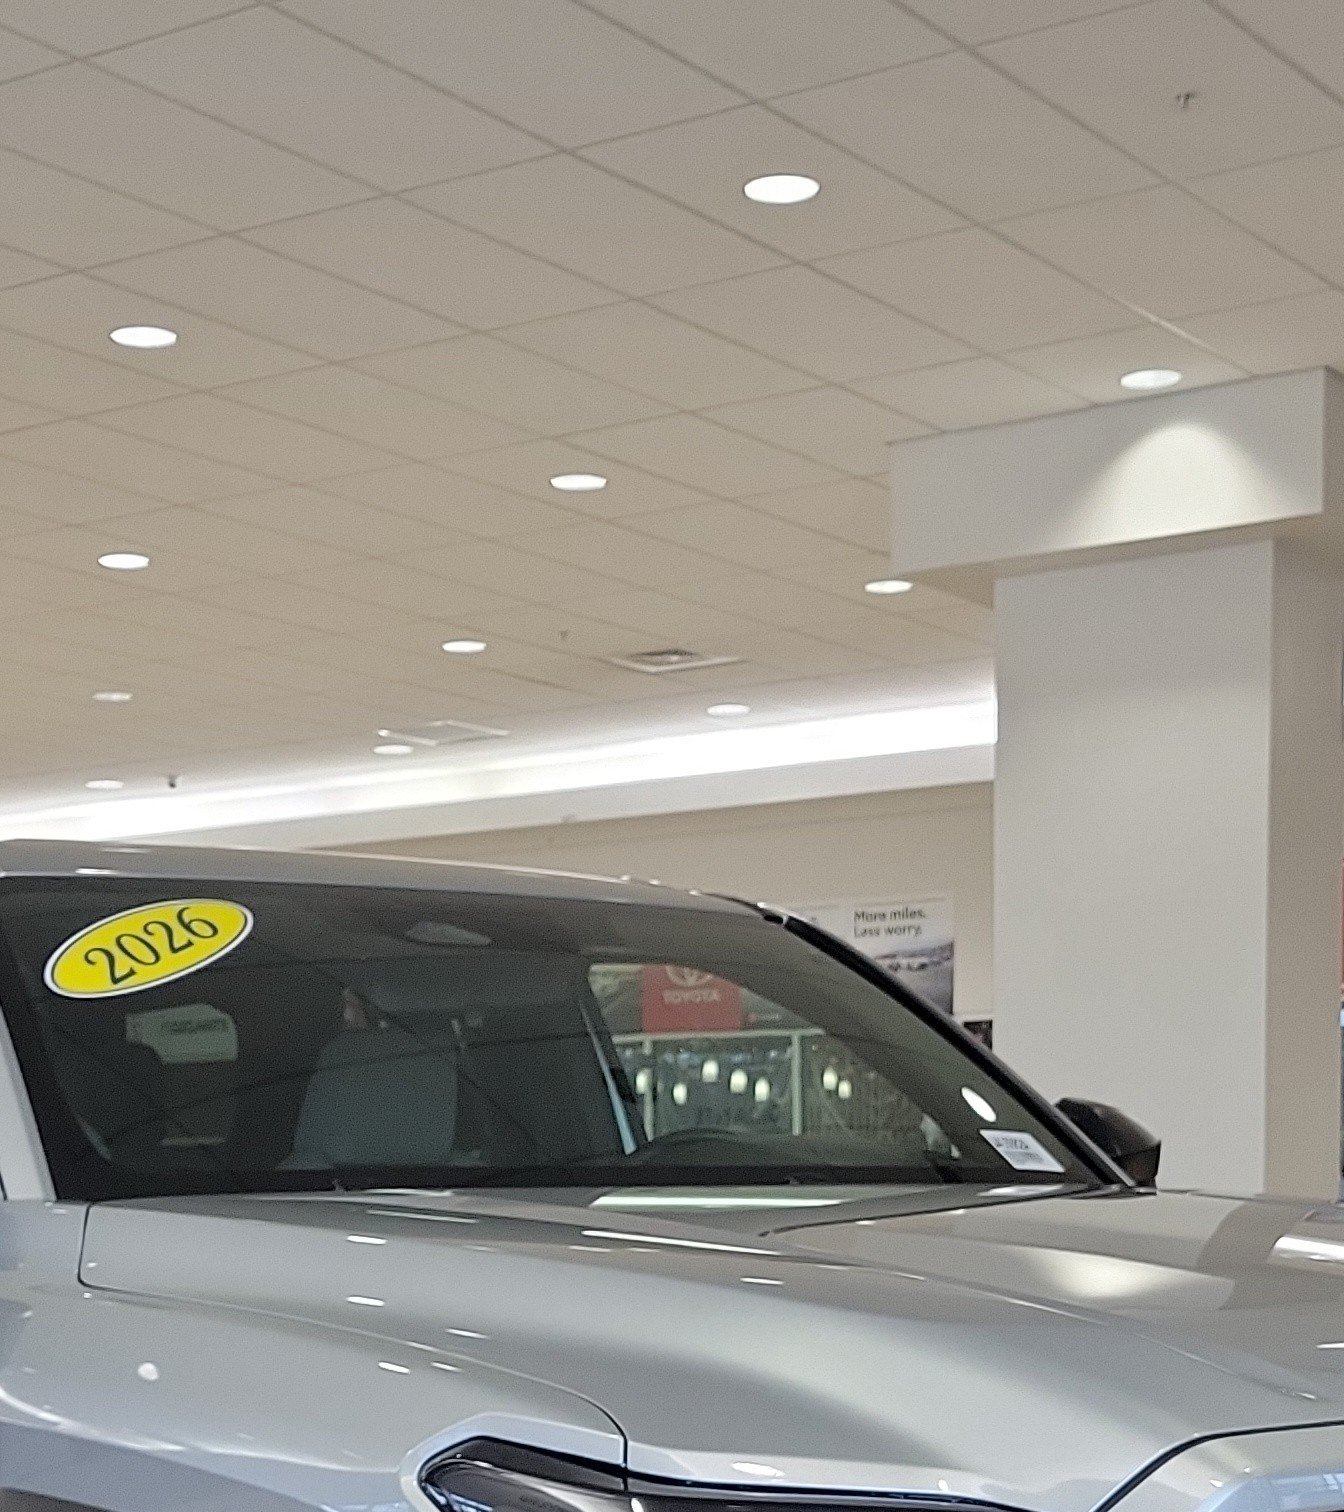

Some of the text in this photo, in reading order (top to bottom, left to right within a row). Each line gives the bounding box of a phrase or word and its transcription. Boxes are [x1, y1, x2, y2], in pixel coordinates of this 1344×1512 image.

[855, 911, 886, 922] More
[854, 926, 880, 938] Less
[84, 907, 219, 985] 2026
